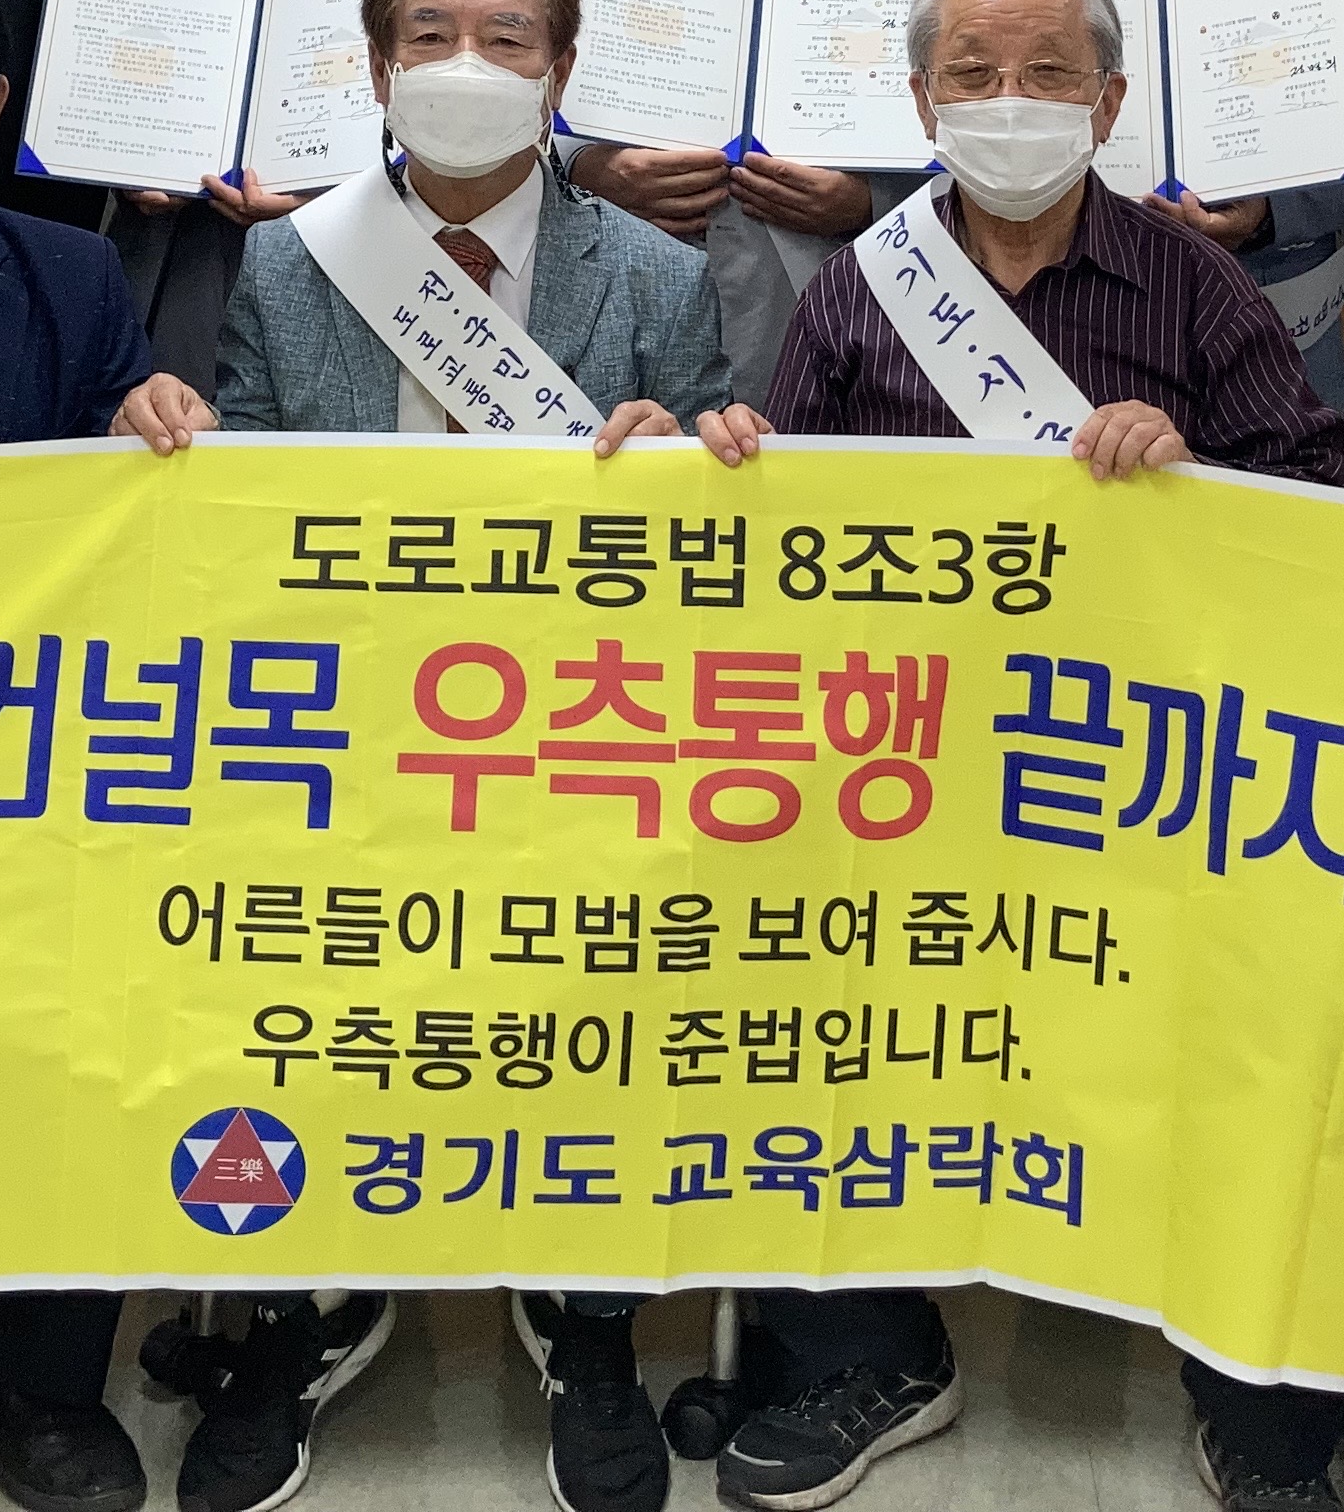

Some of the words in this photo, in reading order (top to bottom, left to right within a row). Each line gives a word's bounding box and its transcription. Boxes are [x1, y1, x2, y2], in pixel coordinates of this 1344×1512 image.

[393, 304, 515, 433] 도로교통법
[279, 514, 750, 608] 도로교통법
[778, 519, 1068, 615] 8조3항
[396, 639, 949, 843] 우측통행
[158, 881, 464, 970] 어른들이
[489, 892, 720, 974] 모범을
[738, 890, 878, 967] 보여
[903, 891, 1130, 986] 줍시다.
[242, 1004, 634, 1090] 우측통행이
[659, 1003, 1031, 1088] 준법입니다.
[214, 1156, 264, 1183] 三樂
[345, 1129, 622, 1215] 경기도
[652, 1121, 1084, 1228] 교육삼락회
